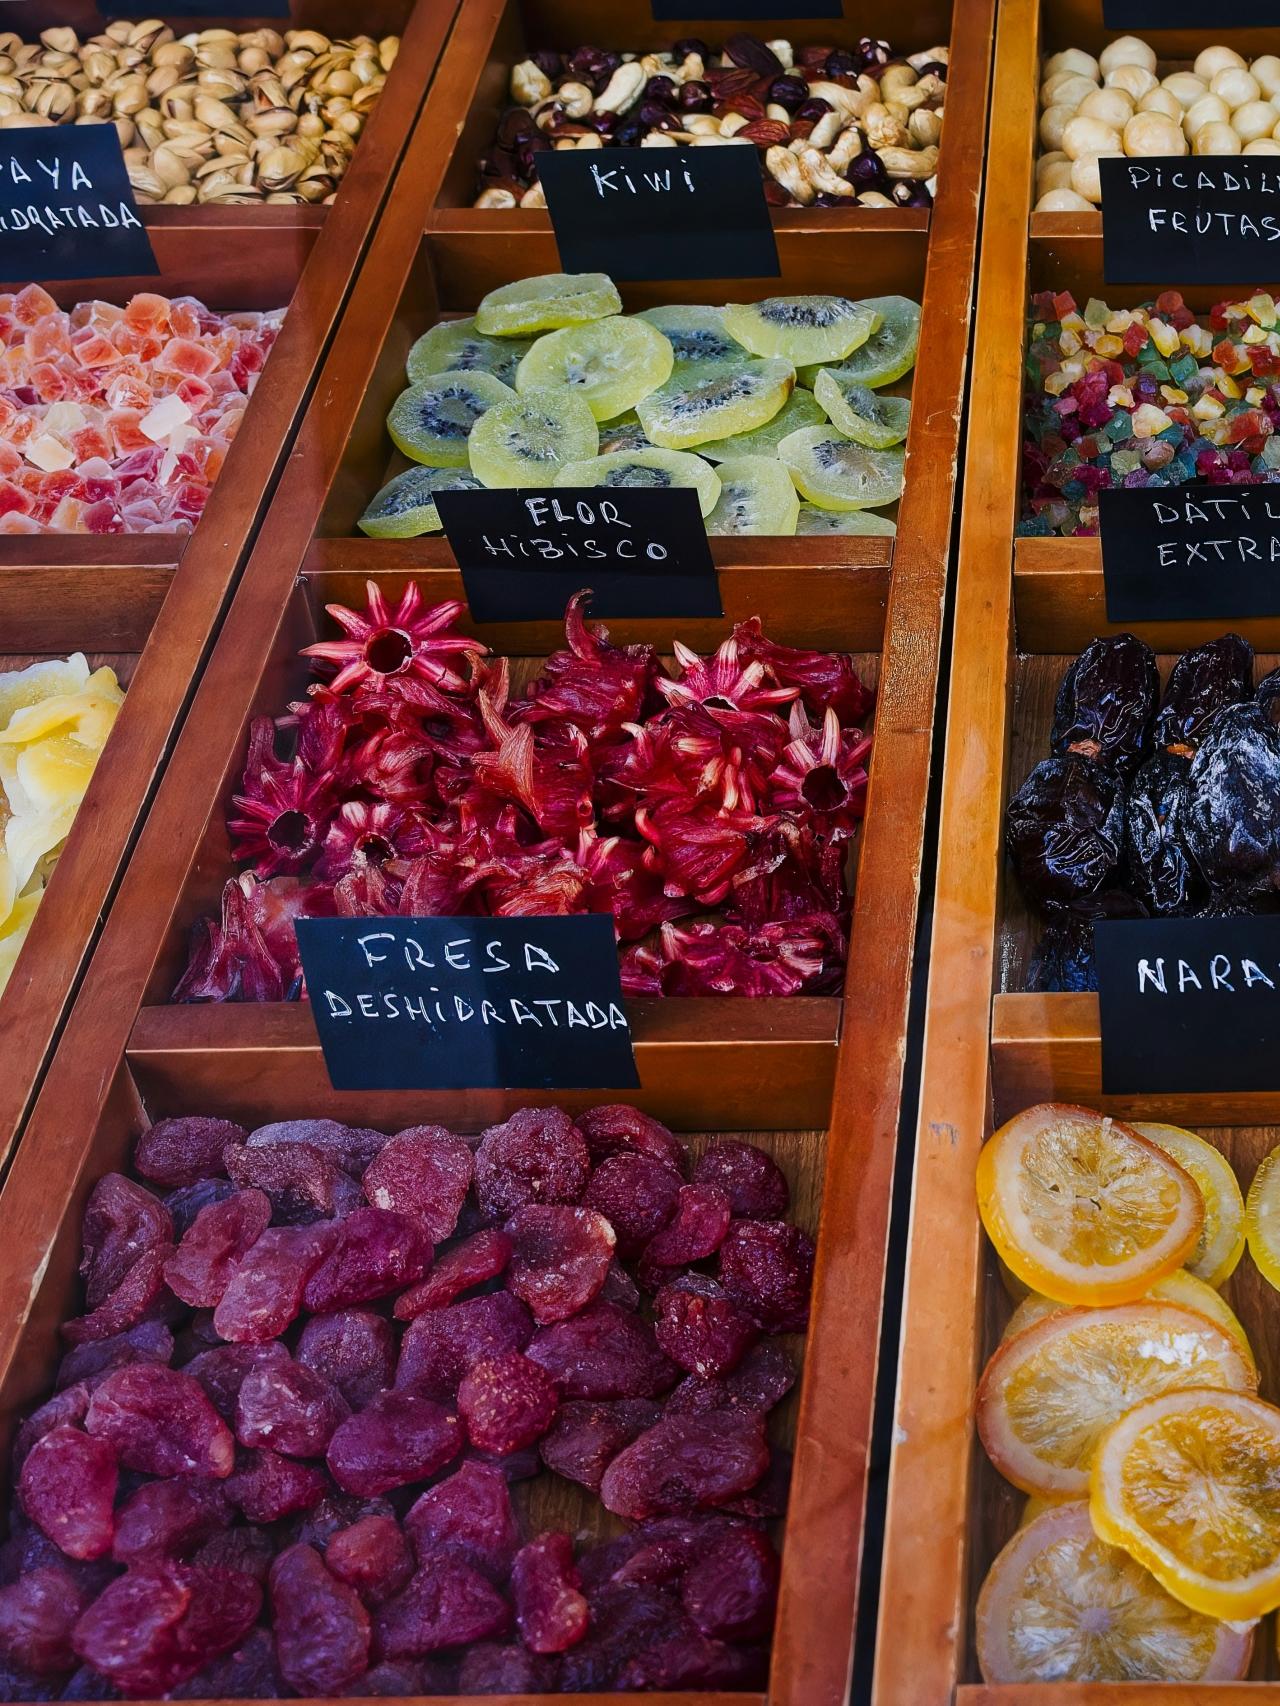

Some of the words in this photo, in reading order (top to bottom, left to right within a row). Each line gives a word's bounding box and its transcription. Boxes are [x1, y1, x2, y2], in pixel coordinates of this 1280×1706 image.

[0, 156, 92, 191] AYA
[1149, 208, 1280, 241] FRUTAS
[525, 497, 632, 528] FLOR
[357, 932, 560, 973] FRESA
